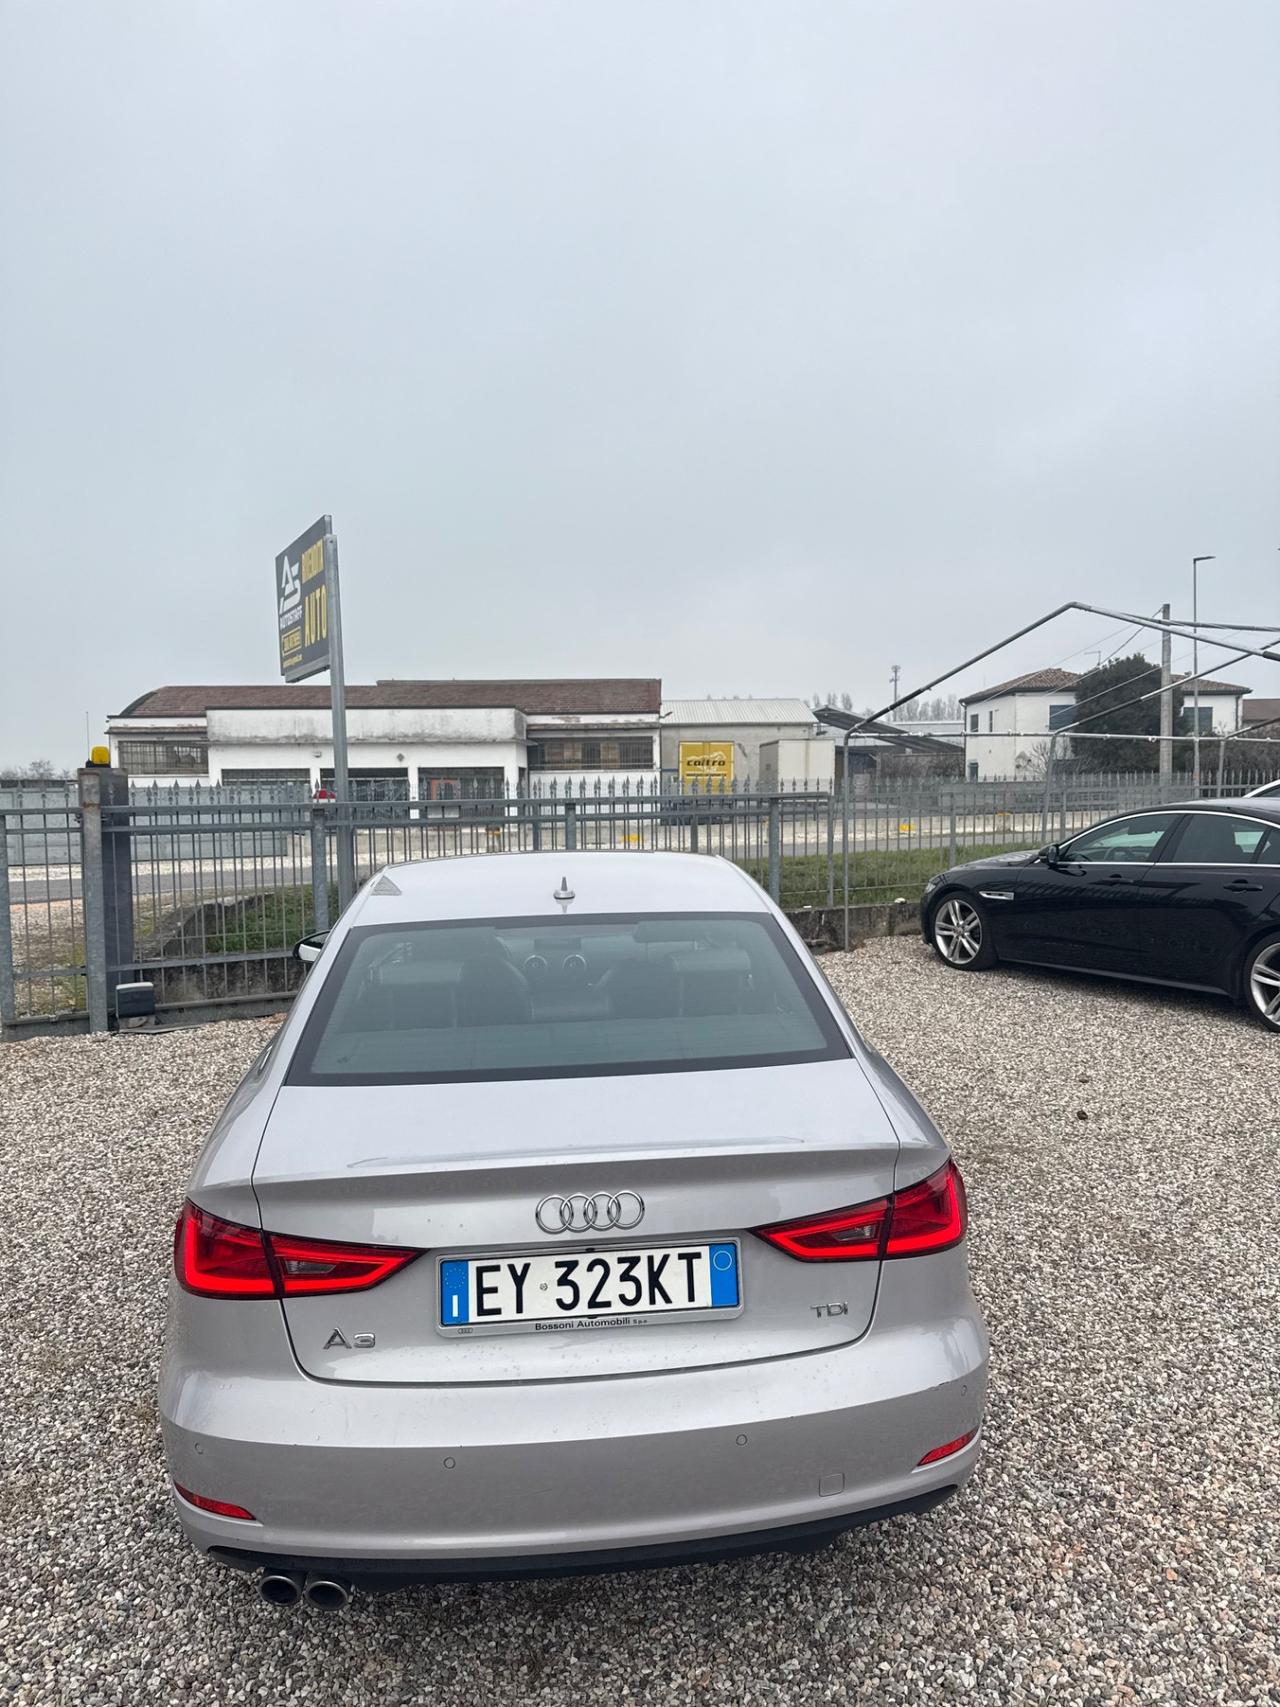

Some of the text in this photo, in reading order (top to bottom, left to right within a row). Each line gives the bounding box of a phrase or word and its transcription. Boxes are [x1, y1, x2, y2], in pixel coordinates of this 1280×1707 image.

[304, 585, 327, 648] AUTO
[476, 1252, 703, 1317] EY 323KT
[323, 1327, 375, 1350] A3
[535, 1320, 574, 1331] Bossoni
[577, 1316, 630, 1328] Automobili
